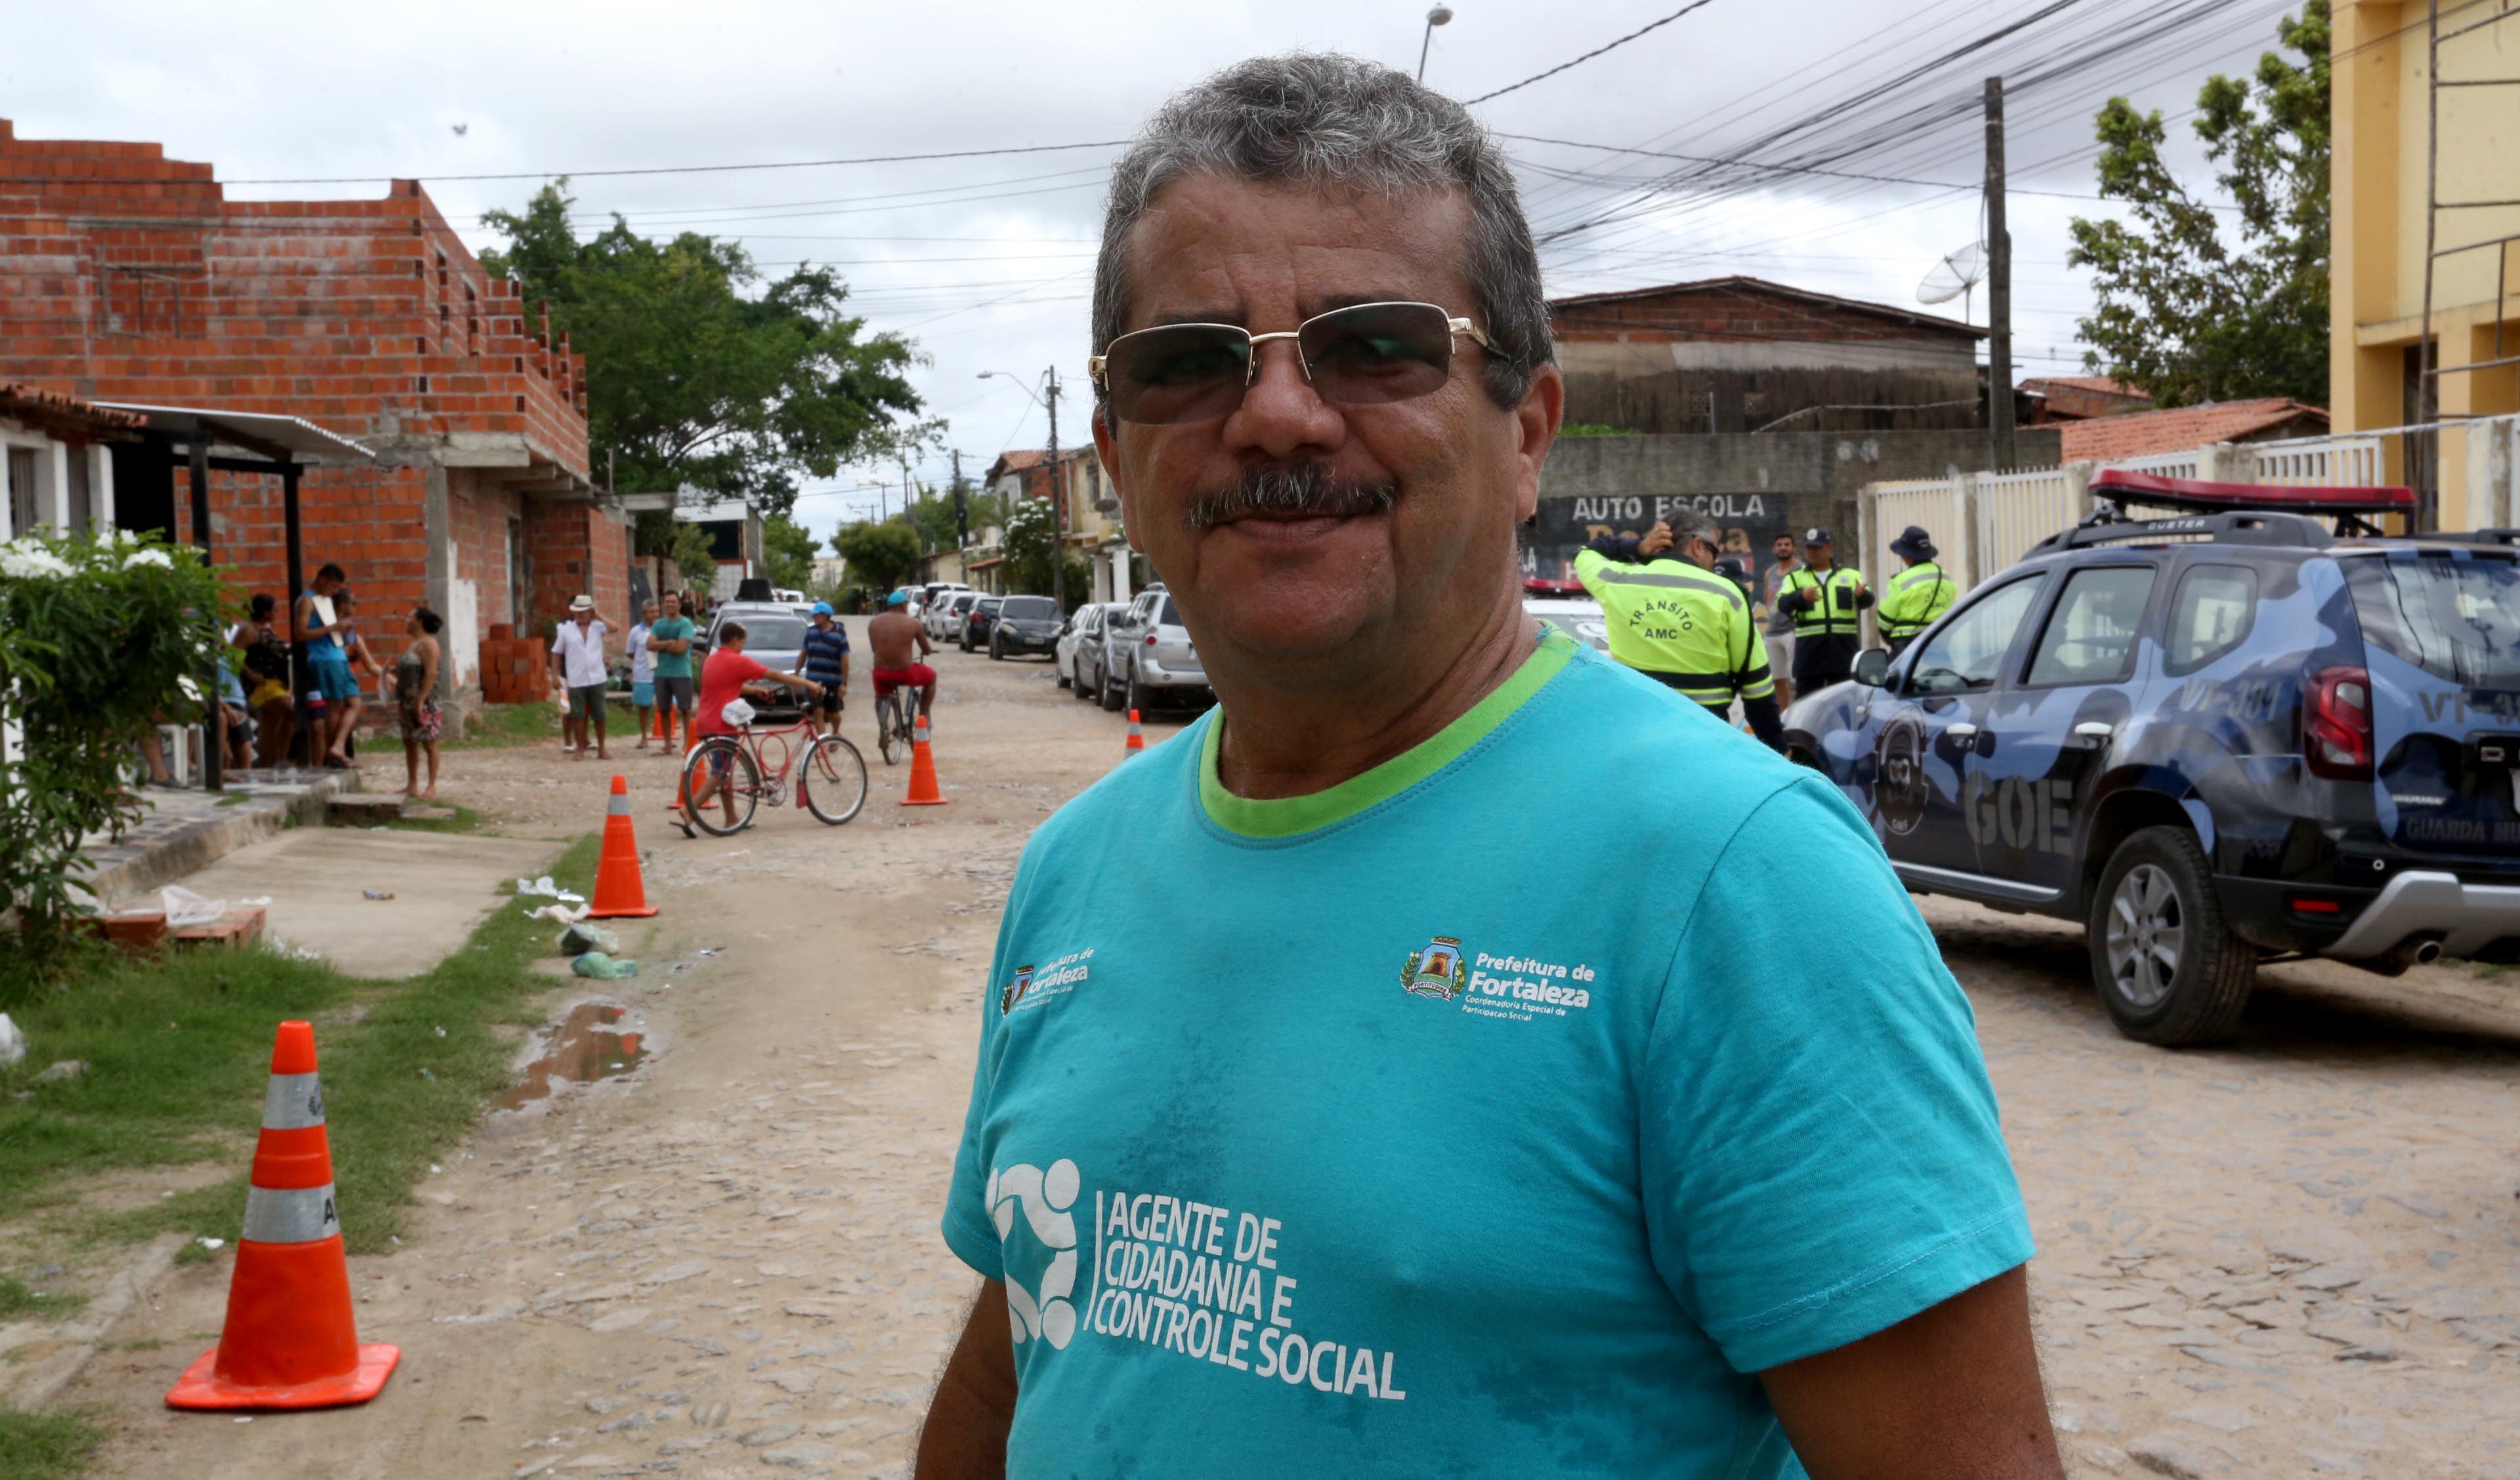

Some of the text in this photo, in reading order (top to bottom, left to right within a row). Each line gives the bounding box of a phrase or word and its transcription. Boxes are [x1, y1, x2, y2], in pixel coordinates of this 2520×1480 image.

[1573, 495, 1765, 520] AUTO ESCOLA
[2147, 520, 2205, 530] DUSTER
[1645, 628, 1678, 640] AMC
[1965, 770, 2073, 855] GOE
[2406, 817, 2486, 841] GUARDA
[1080, 947, 1095, 960] de
[1476, 952, 1595, 981] Prefeitura de
[1028, 965, 1088, 993] ortaleza
[1468, 971, 1589, 1008] Fortaleza
[1465, 995, 1566, 1016] Coordenadoria Especial de
[1509, 1012, 1532, 1021] Social
[1106, 1192, 1282, 1269] AGENTE DE
[1104, 1240, 1297, 1328] CIDADANIA E
[1094, 1288, 1406, 1400] CONTROLE SOCIAL
